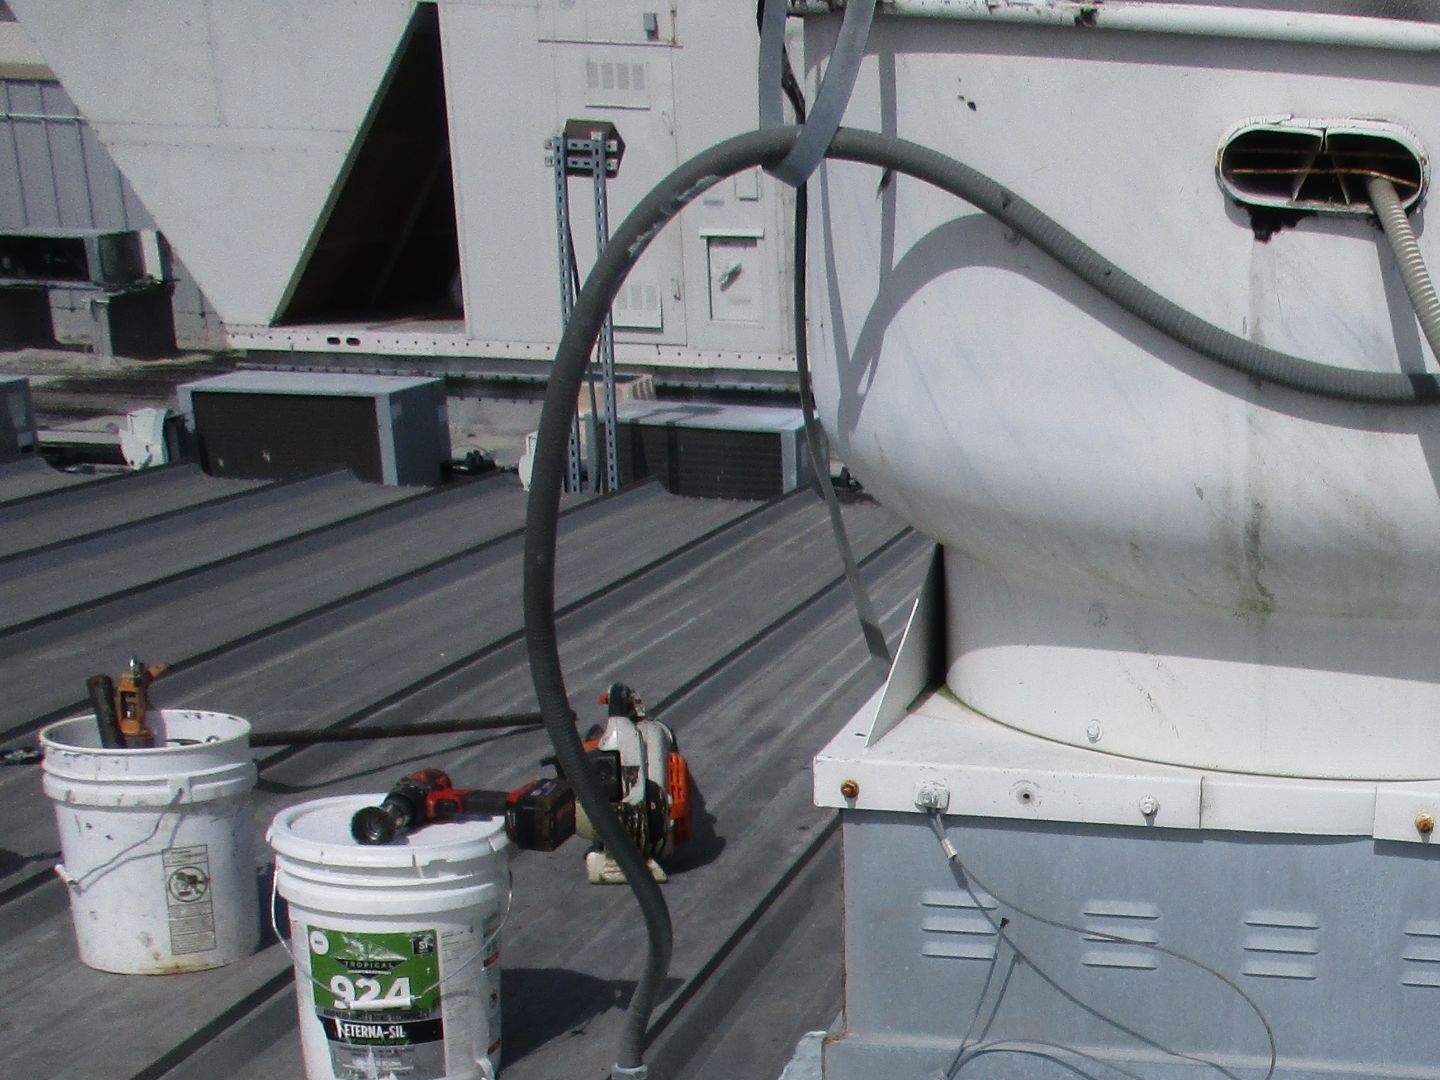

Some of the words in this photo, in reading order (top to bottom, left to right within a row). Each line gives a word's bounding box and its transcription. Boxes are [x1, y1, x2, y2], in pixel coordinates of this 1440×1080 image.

[344, 961, 394, 970] TROPICAL
[330, 975, 411, 1009] 924
[344, 1023, 405, 1039] ETERNA-SIL
